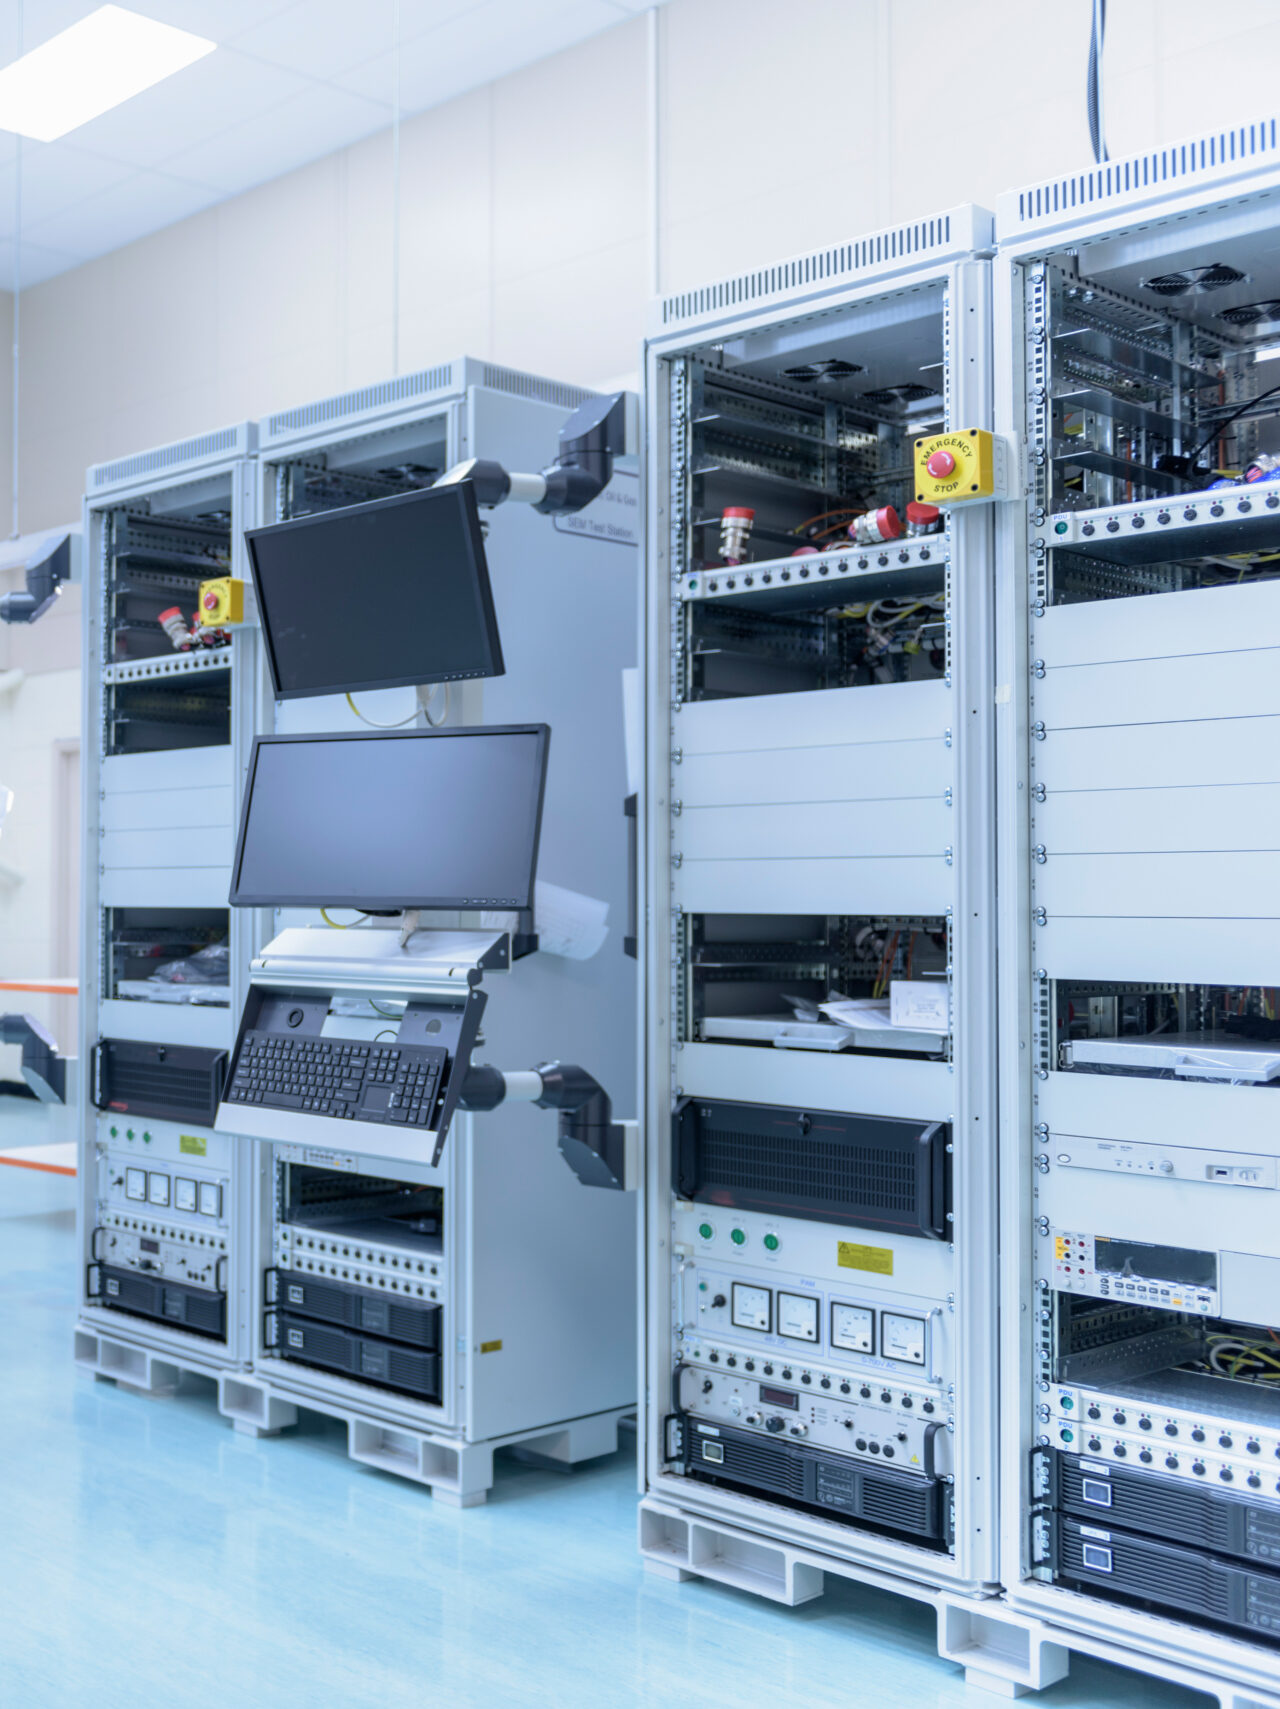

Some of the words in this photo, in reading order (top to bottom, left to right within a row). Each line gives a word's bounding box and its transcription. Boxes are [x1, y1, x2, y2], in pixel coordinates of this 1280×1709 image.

[920, 438, 973, 466] EMERGENCY
[934, 481, 959, 493] STOP
[589, 520, 604, 532] Test
[607, 525, 633, 538] Station
[1058, 1388, 1073, 1397] PDU
[1058, 1421, 1073, 1429] PDU
